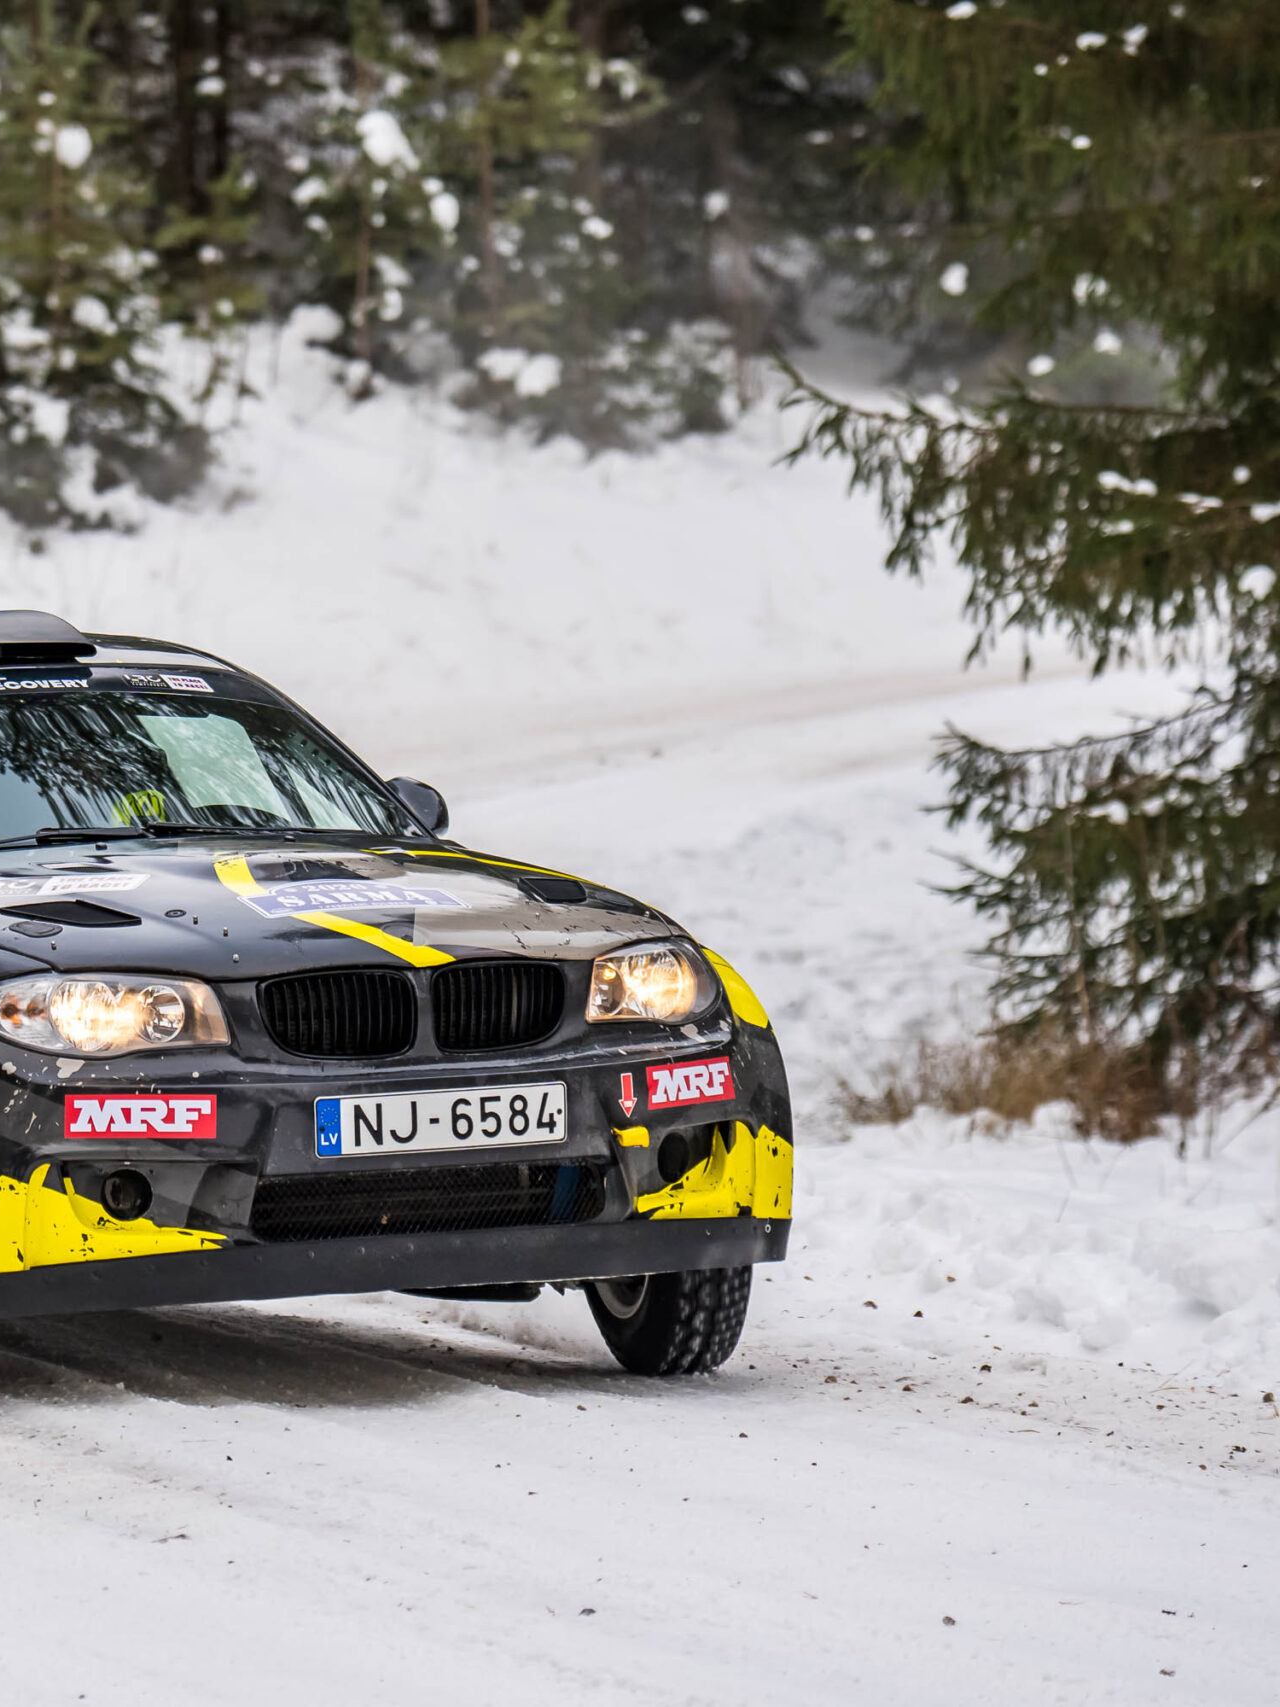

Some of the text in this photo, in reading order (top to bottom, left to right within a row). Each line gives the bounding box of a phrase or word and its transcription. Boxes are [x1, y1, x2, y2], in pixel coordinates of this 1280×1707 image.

[277, 890, 438, 907] SARMA
[652, 1062, 729, 1104] MRF
[70, 1099, 211, 1133] MRF
[353, 1092, 557, 1147] NJ-6584
[320, 1133, 338, 1146] LV
